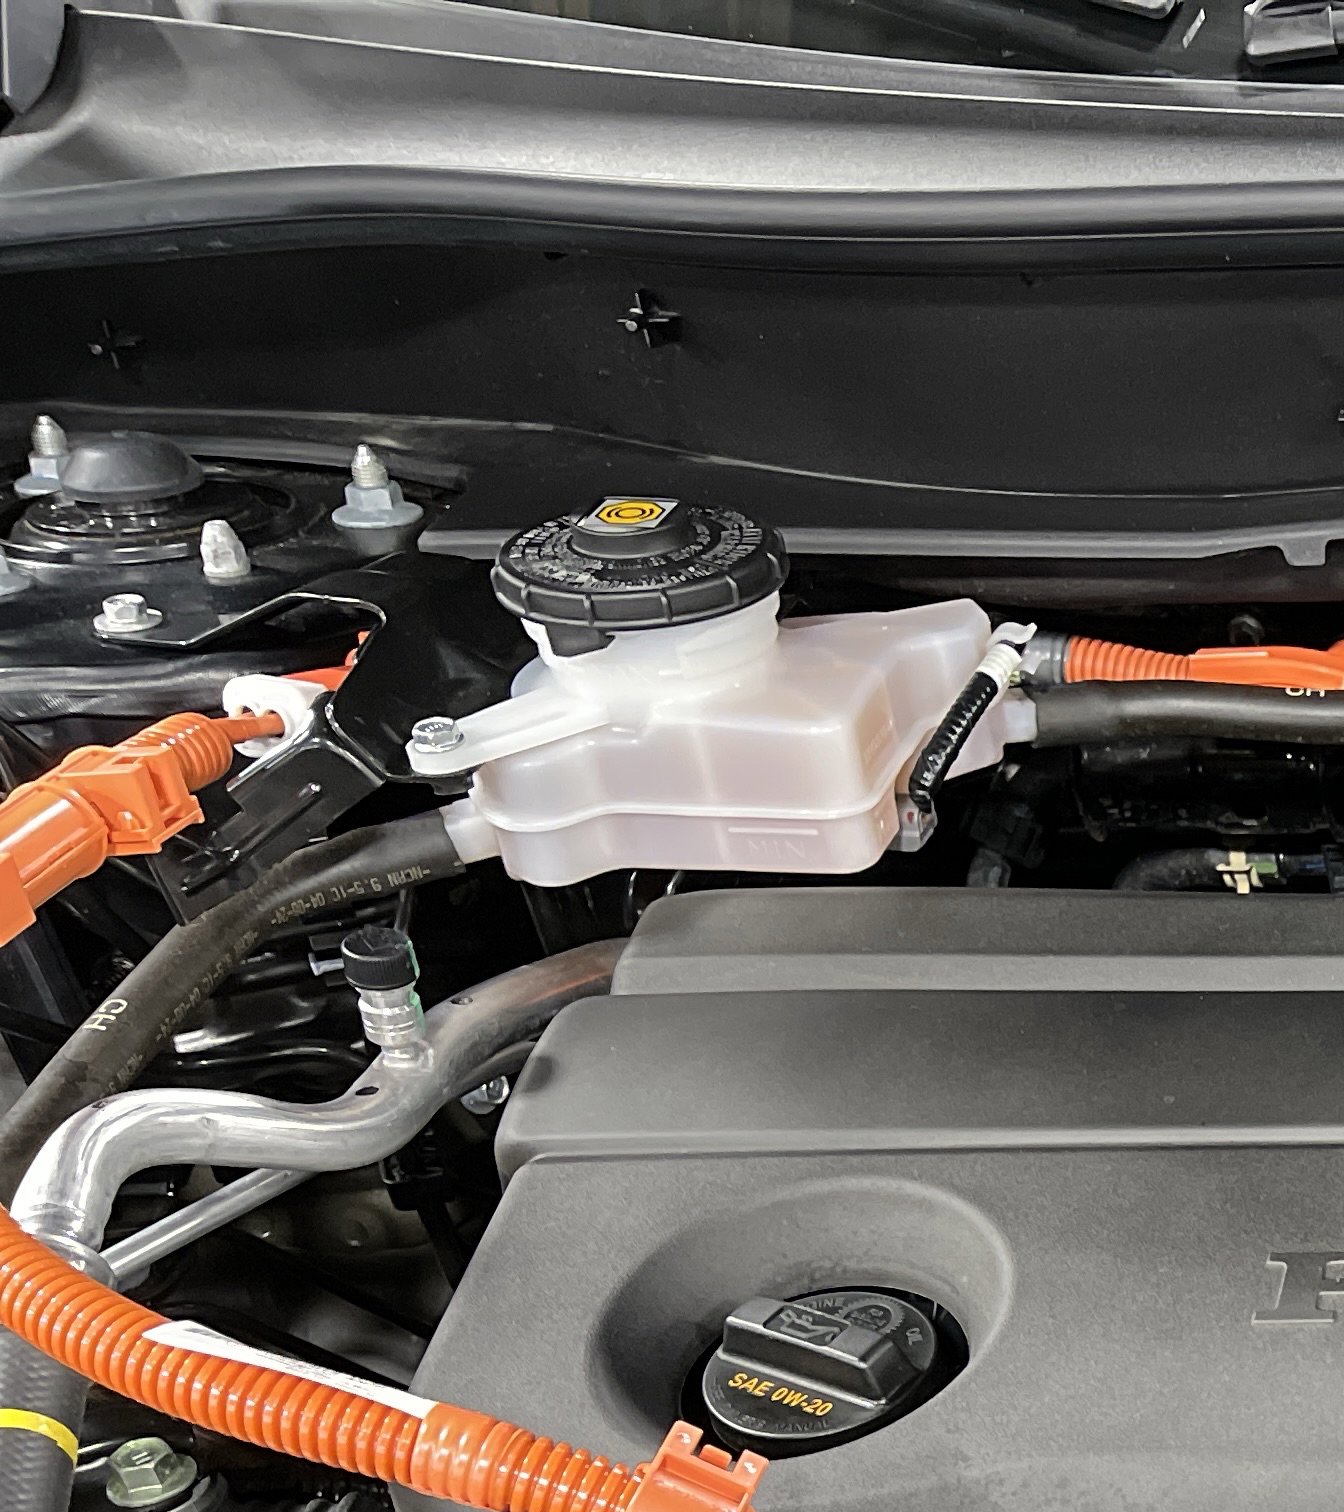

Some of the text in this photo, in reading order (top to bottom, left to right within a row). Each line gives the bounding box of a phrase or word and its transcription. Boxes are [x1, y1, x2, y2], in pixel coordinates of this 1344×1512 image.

[84, 998, 128, 1031] CH
[728, 1372, 774, 1397] SAE
[771, 1387, 833, 1416] 0W-20
